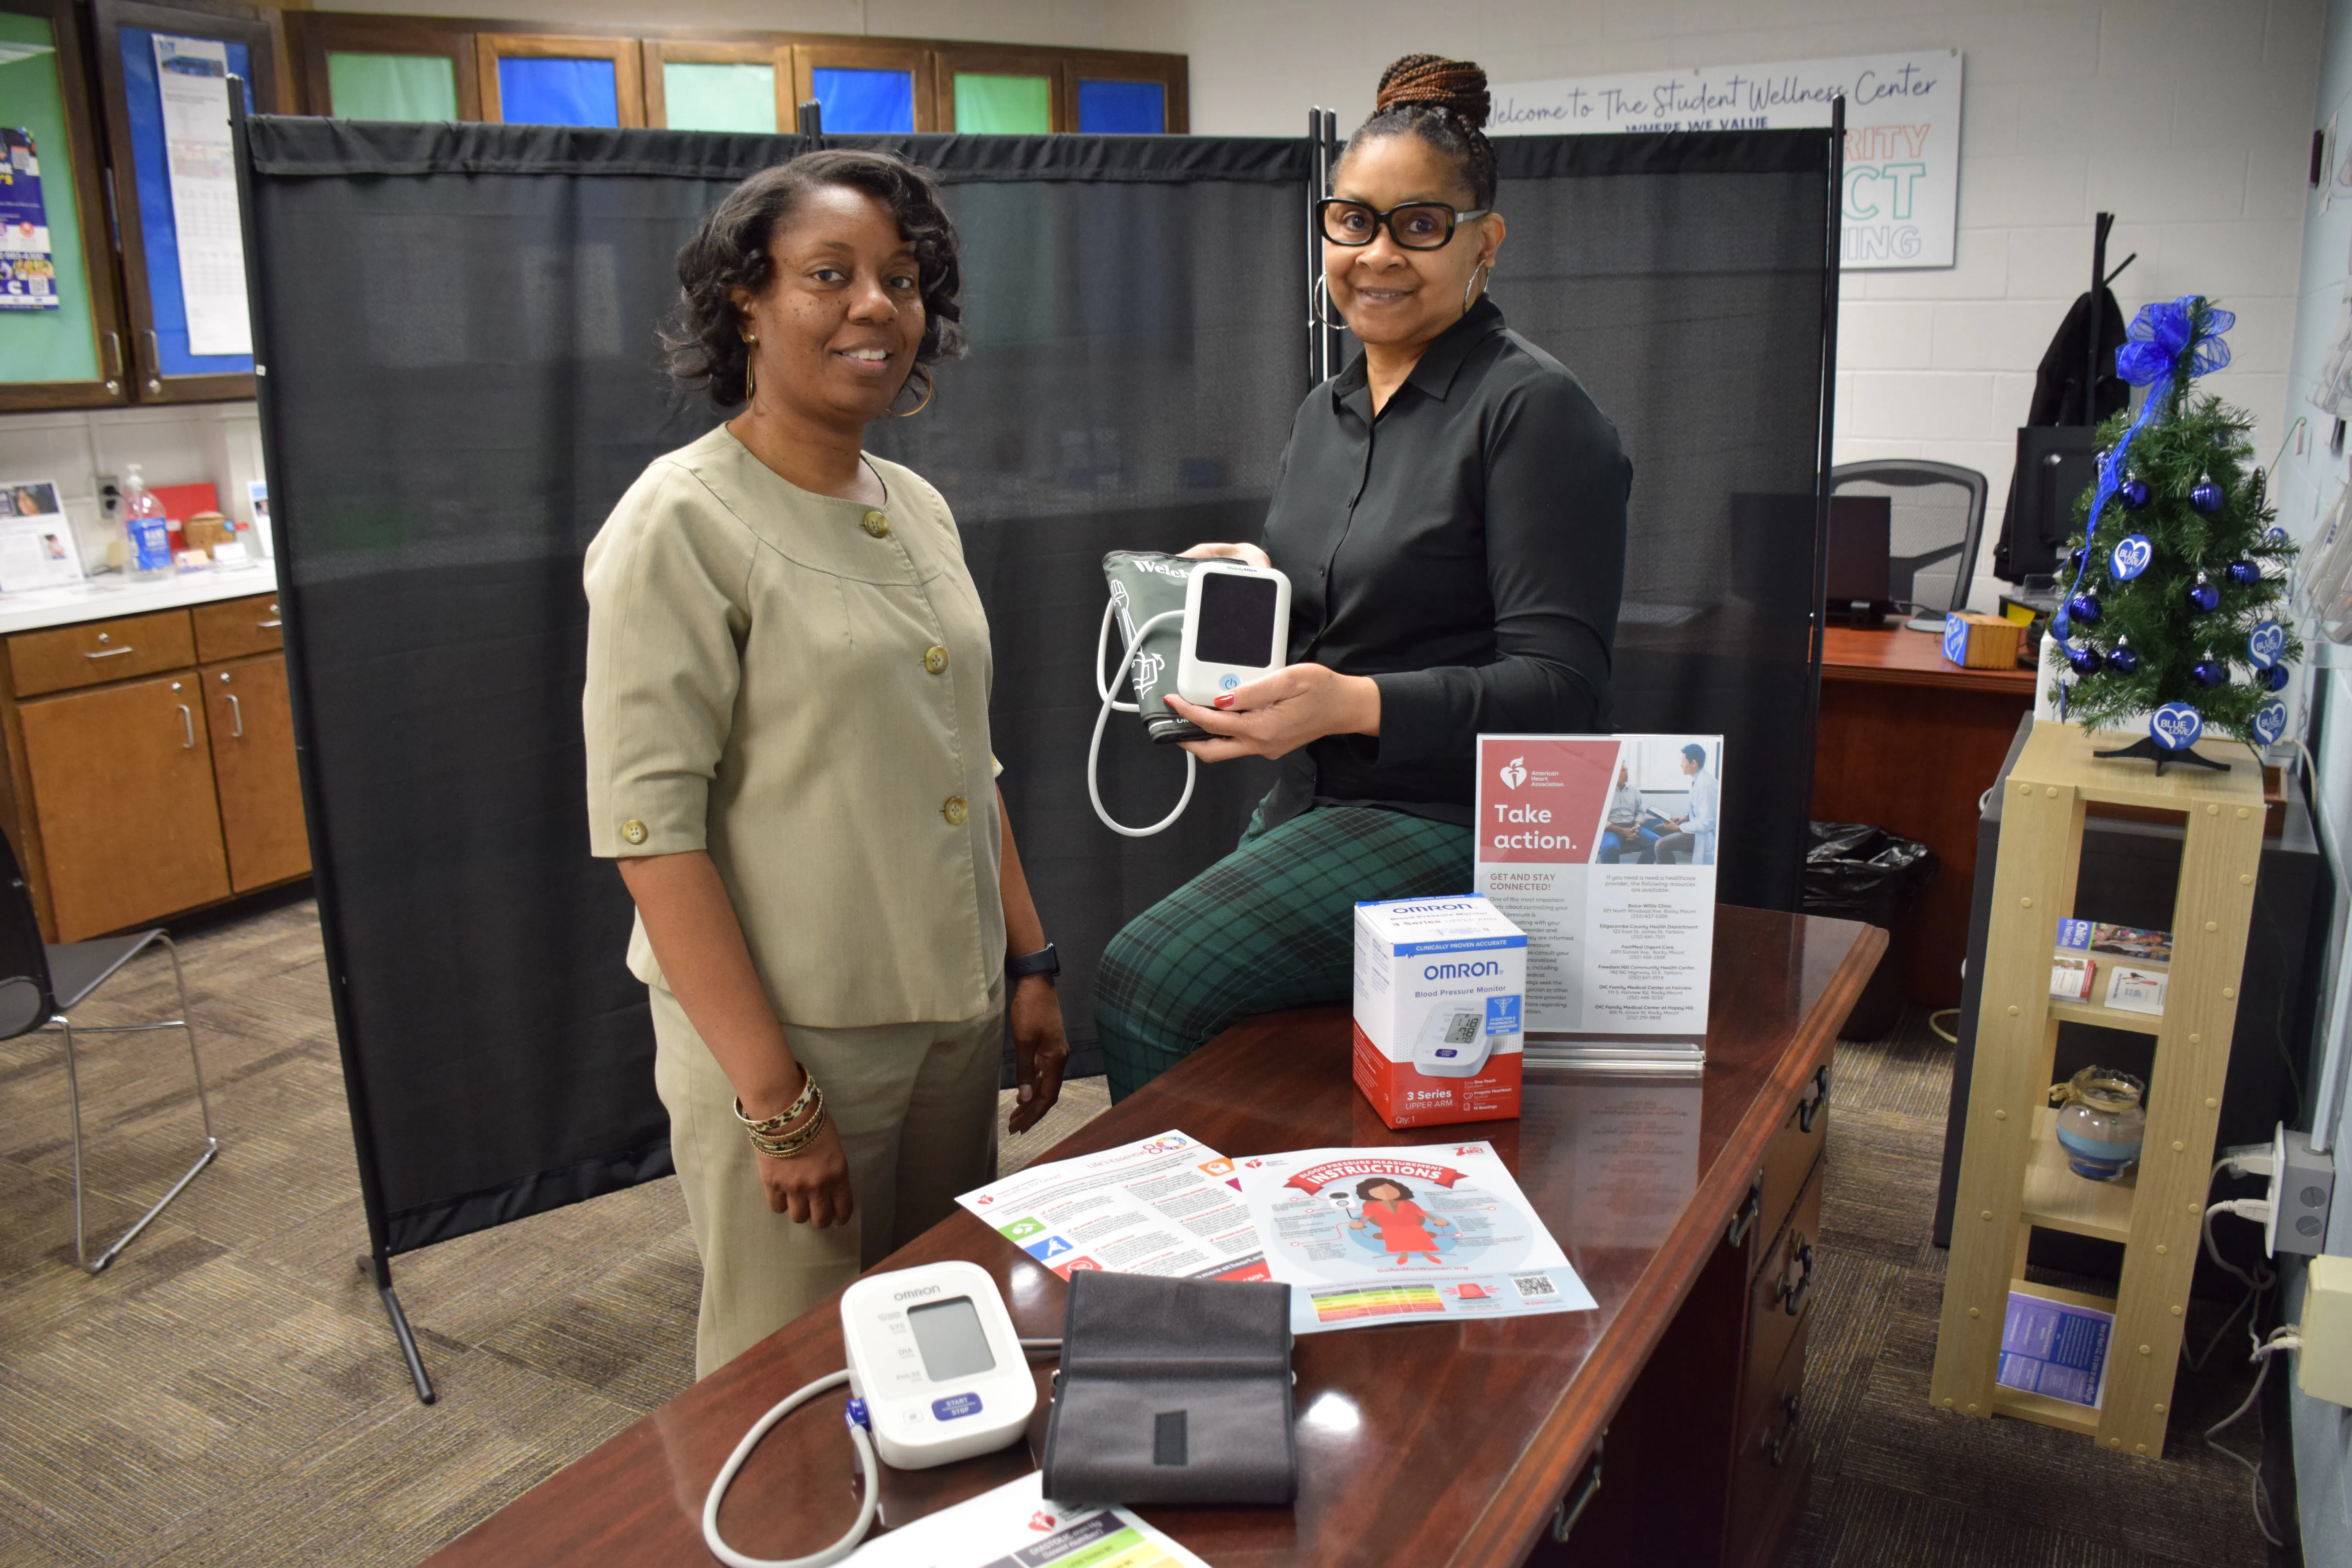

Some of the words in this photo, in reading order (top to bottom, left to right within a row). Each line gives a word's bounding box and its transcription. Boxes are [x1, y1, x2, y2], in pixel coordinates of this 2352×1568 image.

[1568, 87, 1593, 119] to
[1598, 89, 1648, 121] The
[1654, 75, 1747, 118] Student
[1749, 76, 1849, 112] Wellness
[1855, 63, 1936, 105] Center
[1844, 123, 1931, 162] RITY
[1842, 162, 1926, 220] CT
[2119, 549, 2139, 558] BLUE
[2256, 636, 2275, 651] BLUE
[2263, 642, 2278, 653] LOVE
[2160, 719, 2187, 729] BLUE
[2261, 714, 2278, 727] BLUE
[2267, 720, 2280, 730] LOVE
[1494, 804, 1552, 823] Take
[1494, 831, 1577, 849] action.
[1459, 1027, 1475, 1037] 78
[1406, 1091, 1414, 1100] 3
[1417, 1089, 1452, 1100] Series
[1406, 1102, 1432, 1110] UPPER
[1109, 1149, 1147, 1163] Essential
[1143, 1144, 1163, 1154] 8
[1299, 1166, 1327, 1179] BLOOD
[1327, 1160, 1371, 1169] PRESSURE
[1372, 1160, 1444, 1171] MEASUREMENT
[1307, 1164, 1442, 1184] INSTRUCTIONS
[1201, 1267, 1222, 1278] more
[889, 1323, 906, 1331] SYS
[898, 1347, 913, 1356] DIA
[896, 1370, 921, 1380] PULSE
[947, 1397, 967, 1406] START
[952, 1407, 969, 1415] STOP
[1029, 1532, 1073, 1555] DIASTOLIC
[1073, 1524, 1089, 1536] mm
[1089, 1520, 1103, 1530] Hg
[1042, 1540, 1070, 1559] (lower
[1069, 1529, 1104, 1547] number)
